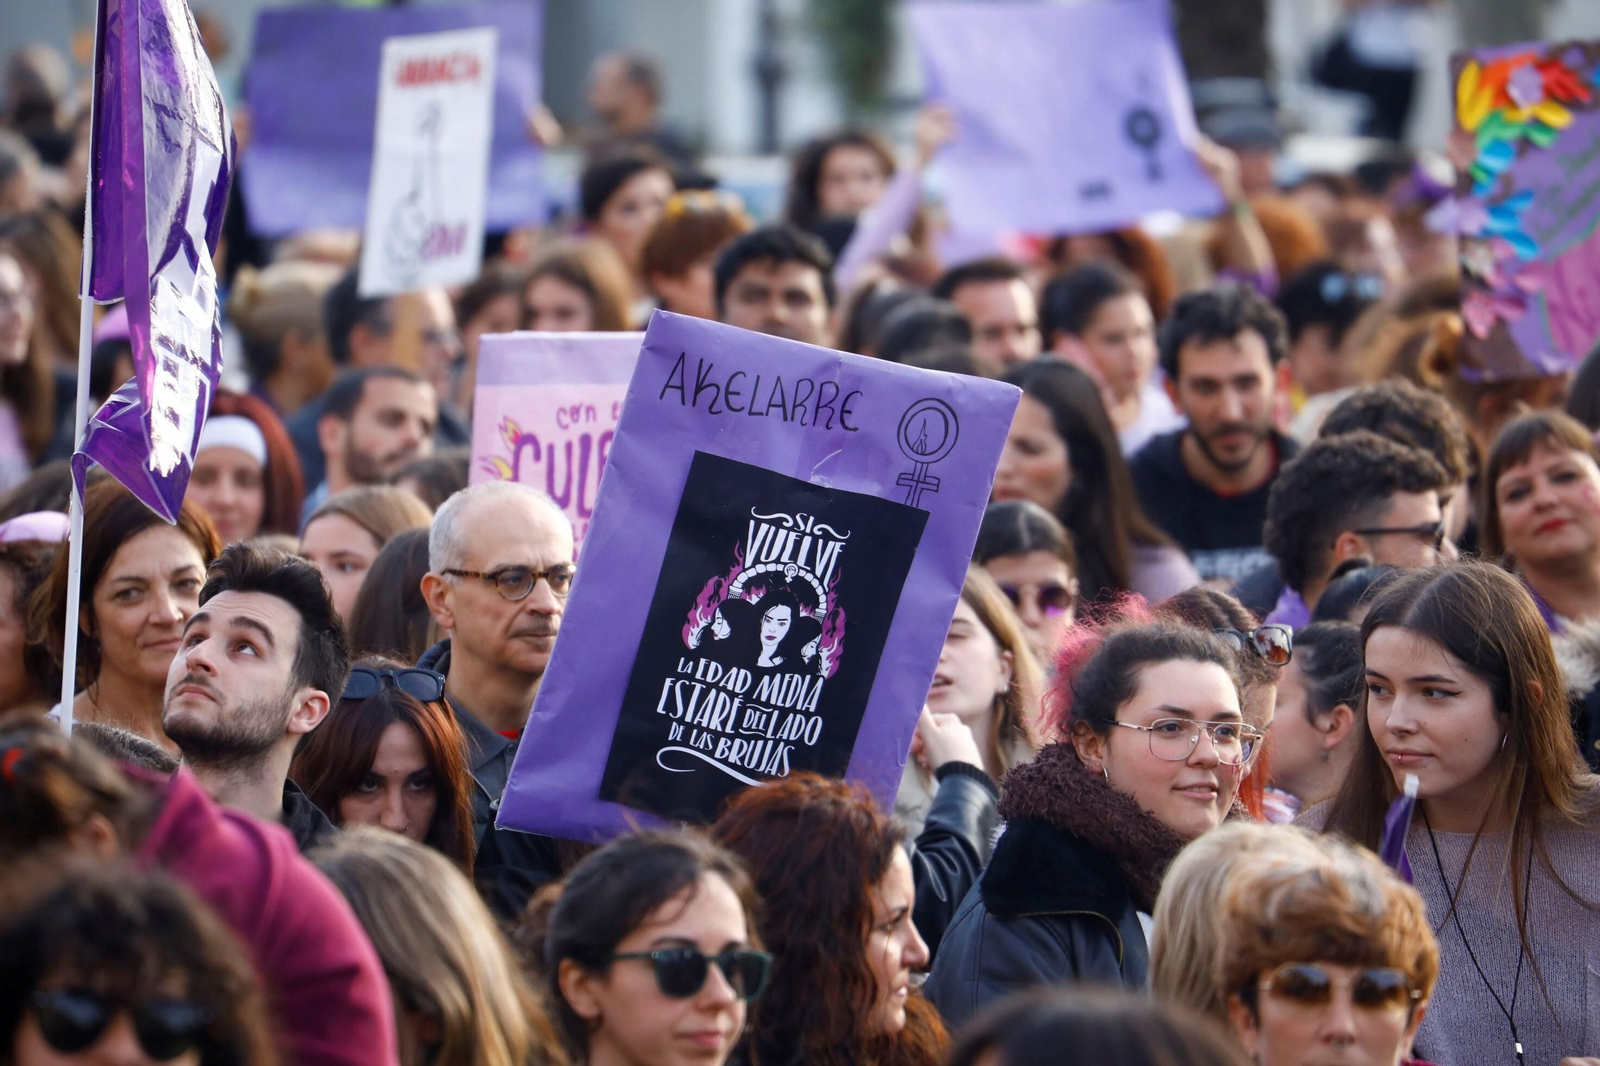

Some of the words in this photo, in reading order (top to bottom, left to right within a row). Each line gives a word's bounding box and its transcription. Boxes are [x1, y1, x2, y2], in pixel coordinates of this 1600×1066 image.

[659, 351, 863, 432] AKELARRE
[794, 512, 815, 533] SI
[744, 519, 846, 592] VUELVE
[656, 677, 745, 733] ESTARÉ
[742, 708, 767, 731] DEL
[765, 710, 824, 746] LADO
[677, 657, 694, 674] LA
[695, 657, 752, 694] EDAD
[752, 673, 825, 712] MEDIA
[668, 721, 686, 741] DE
[689, 729, 715, 750] LAS
[714, 737, 795, 778] BRUJAS
